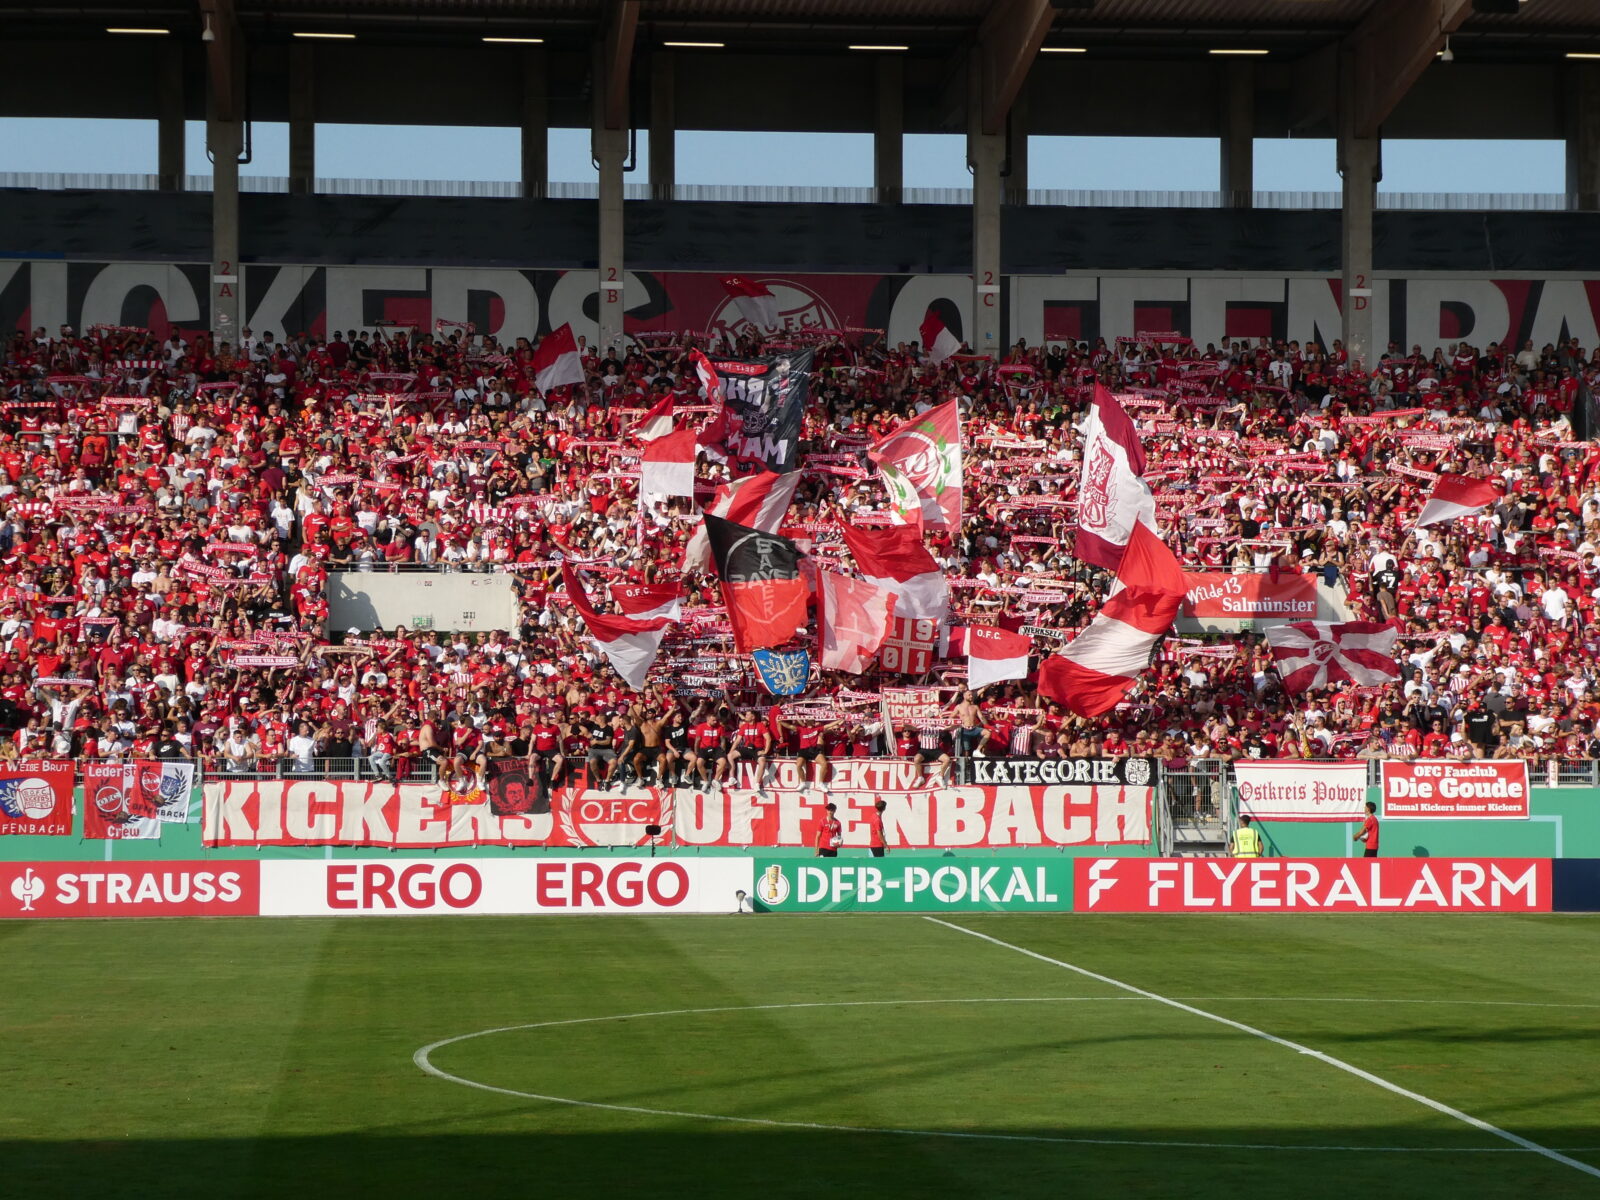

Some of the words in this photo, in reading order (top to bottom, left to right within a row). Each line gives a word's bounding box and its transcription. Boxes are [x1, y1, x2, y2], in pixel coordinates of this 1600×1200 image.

[221, 261, 231, 275] 2
[607, 267, 617, 281] 2
[984, 271, 994, 285] 2
[1355, 275, 1365, 288] 2
[220, 283, 233, 297] A
[606, 289, 618, 303] B
[984, 293, 995, 307] C
[1354, 296, 1368, 310] D
[505, 561, 562, 571] KICKERS
[626, 587, 652, 597] O.F.C.
[1187, 584, 1223, 605] Wilde
[1223, 576, 1242, 594] 13
[1222, 597, 1315, 613] Salmünster
[976, 628, 1002, 640] O.F.C.
[1023, 626, 1063, 639] WERKSELF
[922, 689, 940, 704] ON
[887, 703, 940, 718] ICKERS
[42, 760, 70, 772] BRUT
[975, 760, 1120, 784] KATEGORIE
[1413, 766, 1440, 778] OFC
[1444, 766, 1498, 778] Fanclub
[1238, 780, 1307, 802] Ostkreis
[1312, 780, 1365, 805] Power
[1388, 778, 1432, 798] Die
[1438, 778, 1523, 798] Goude
[580, 801, 655, 822] O.F.C.
[1387, 803, 1421, 812] Einmal
[1424, 803, 1454, 812] Kickers
[1456, 803, 1484, 812] immer
[1487, 803, 1522, 812] Kickers
[675, 786, 1150, 845] OFFENBACH
[107, 825, 140, 837] Crew
[55, 872, 242, 904] STRAUSS
[326, 863, 483, 910] ERGO
[535, 861, 690, 907] ERGO
[797, 866, 1058, 904] DFB-POKAL
[1149, 861, 1537, 908] FLYERALARM
